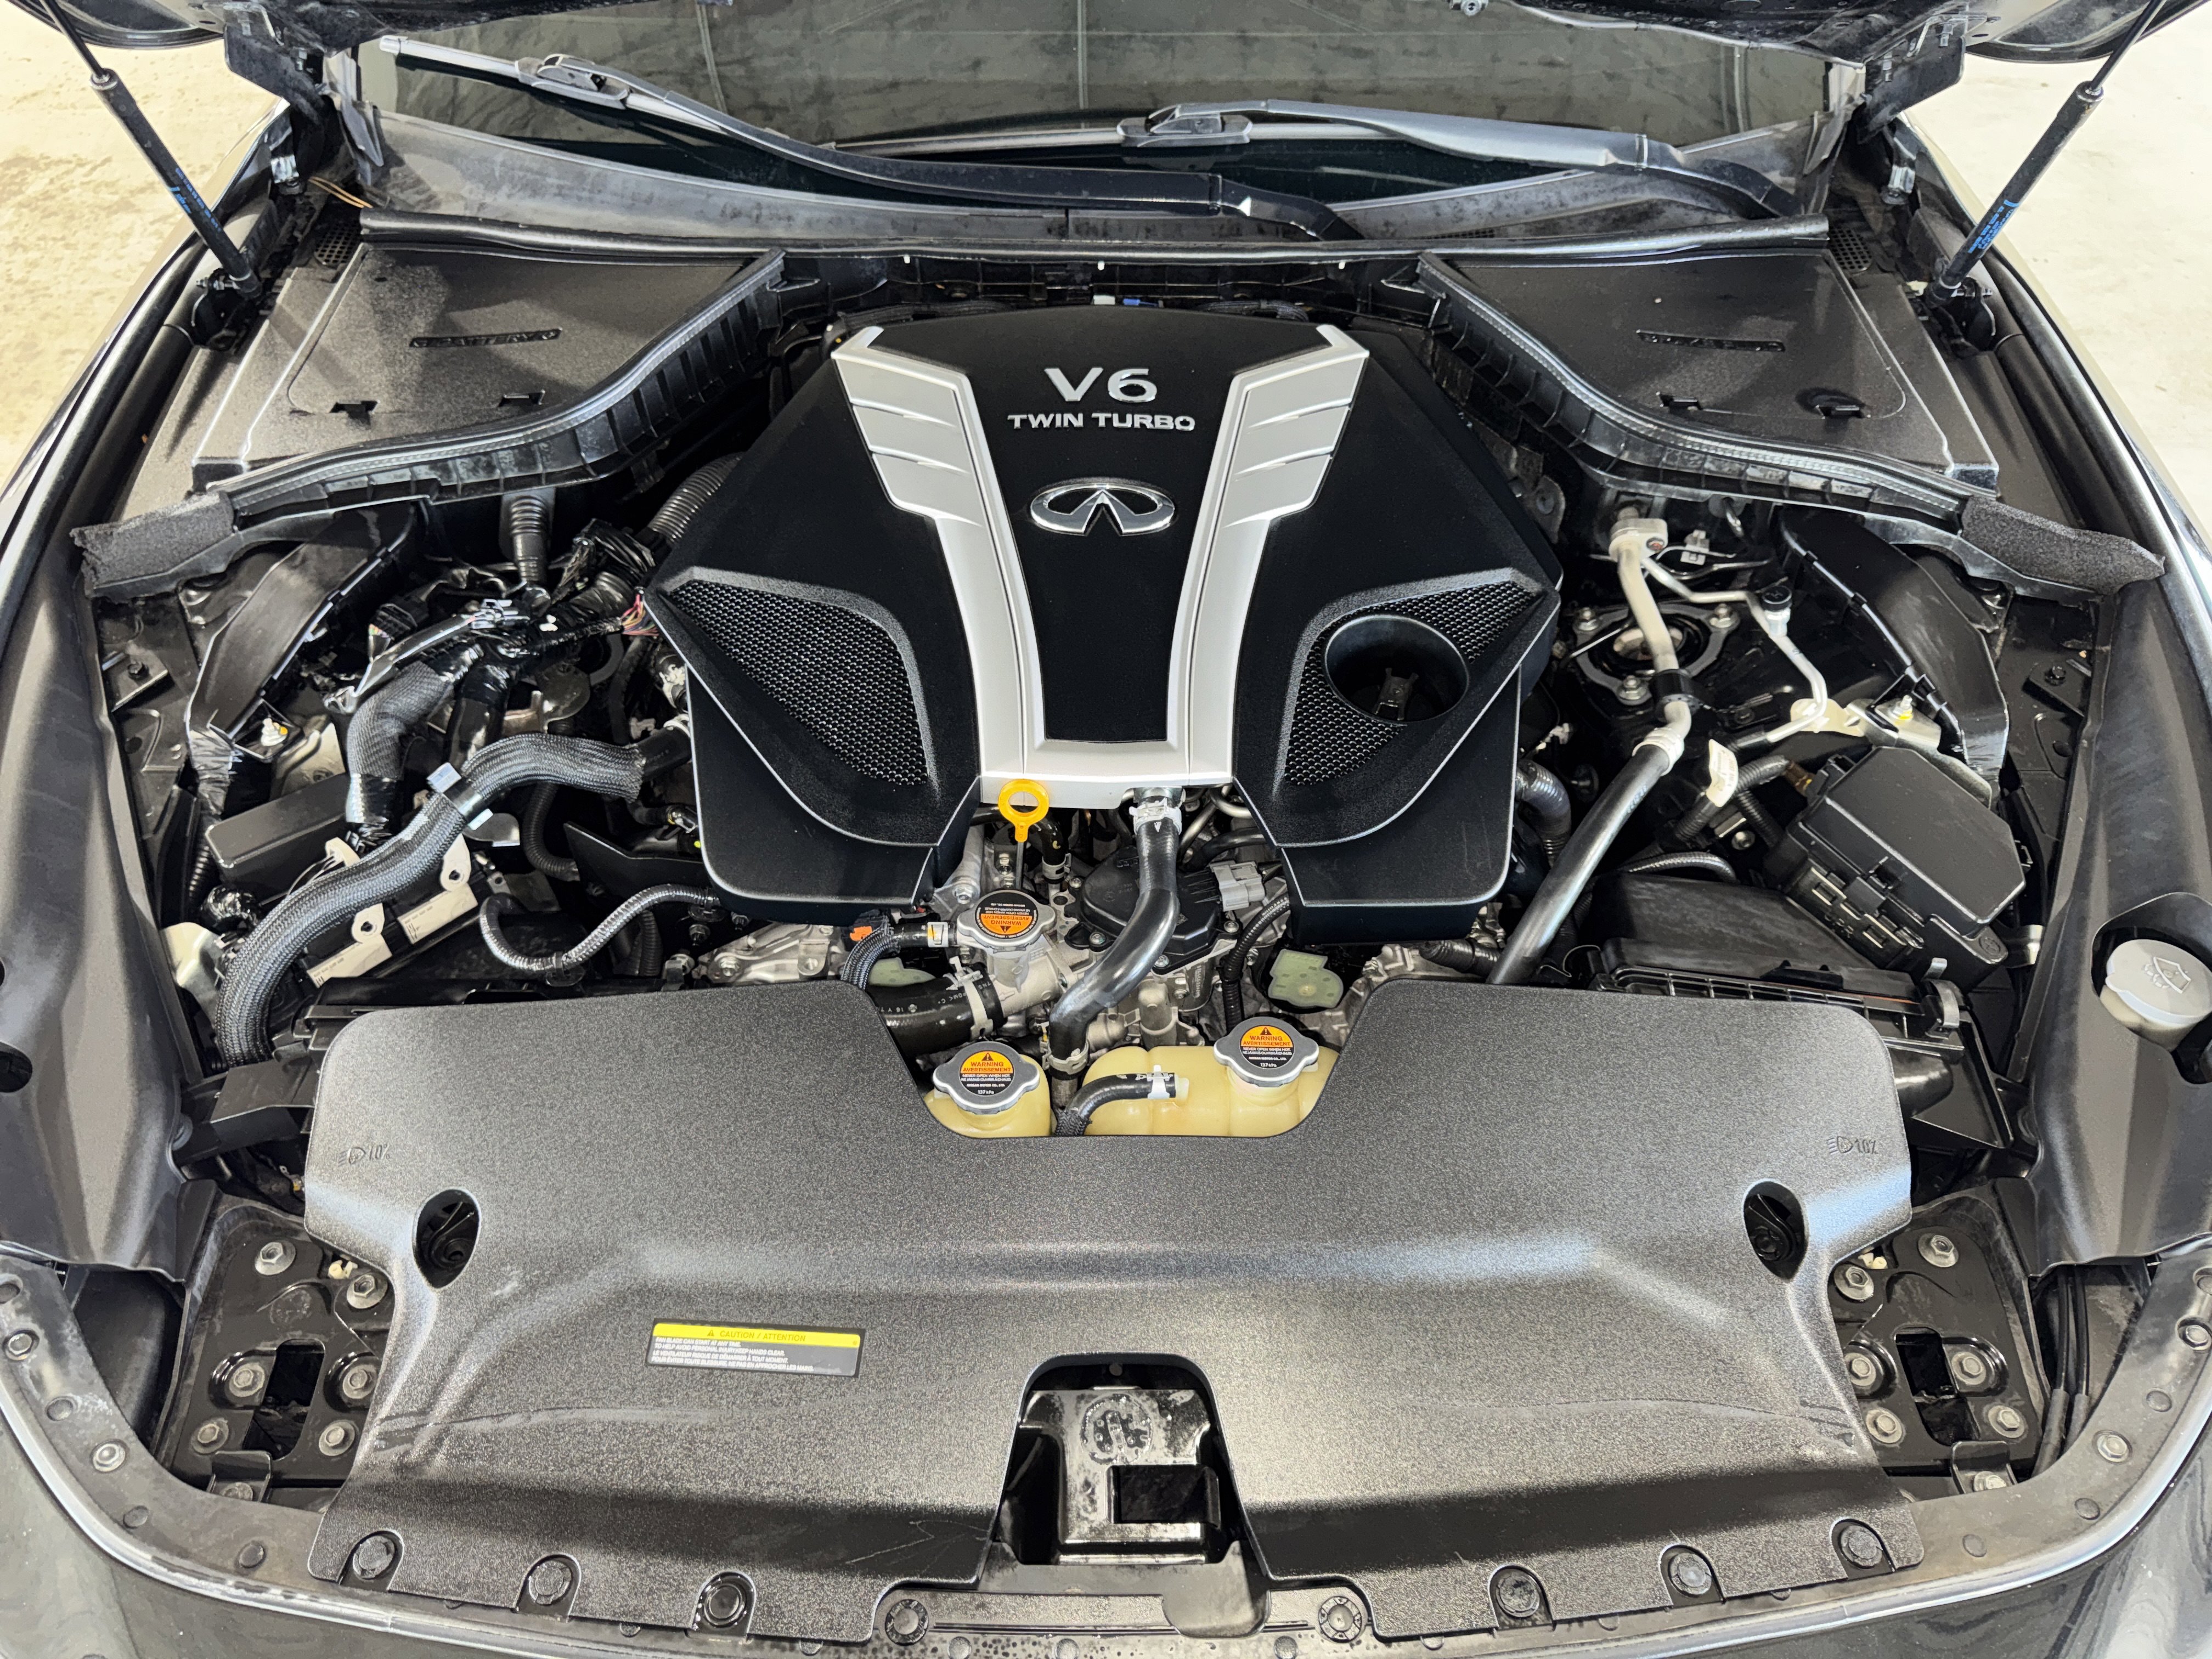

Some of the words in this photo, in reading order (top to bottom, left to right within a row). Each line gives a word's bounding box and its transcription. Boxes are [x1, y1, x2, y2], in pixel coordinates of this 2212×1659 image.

[1044, 367, 1157, 403] V6
[1007, 413, 1084, 429] TWIN
[1091, 413, 1195, 431] TURBO
[720, 1330, 754, 1339] CAUTION
[763, 1333, 806, 1341] ATTENTION
